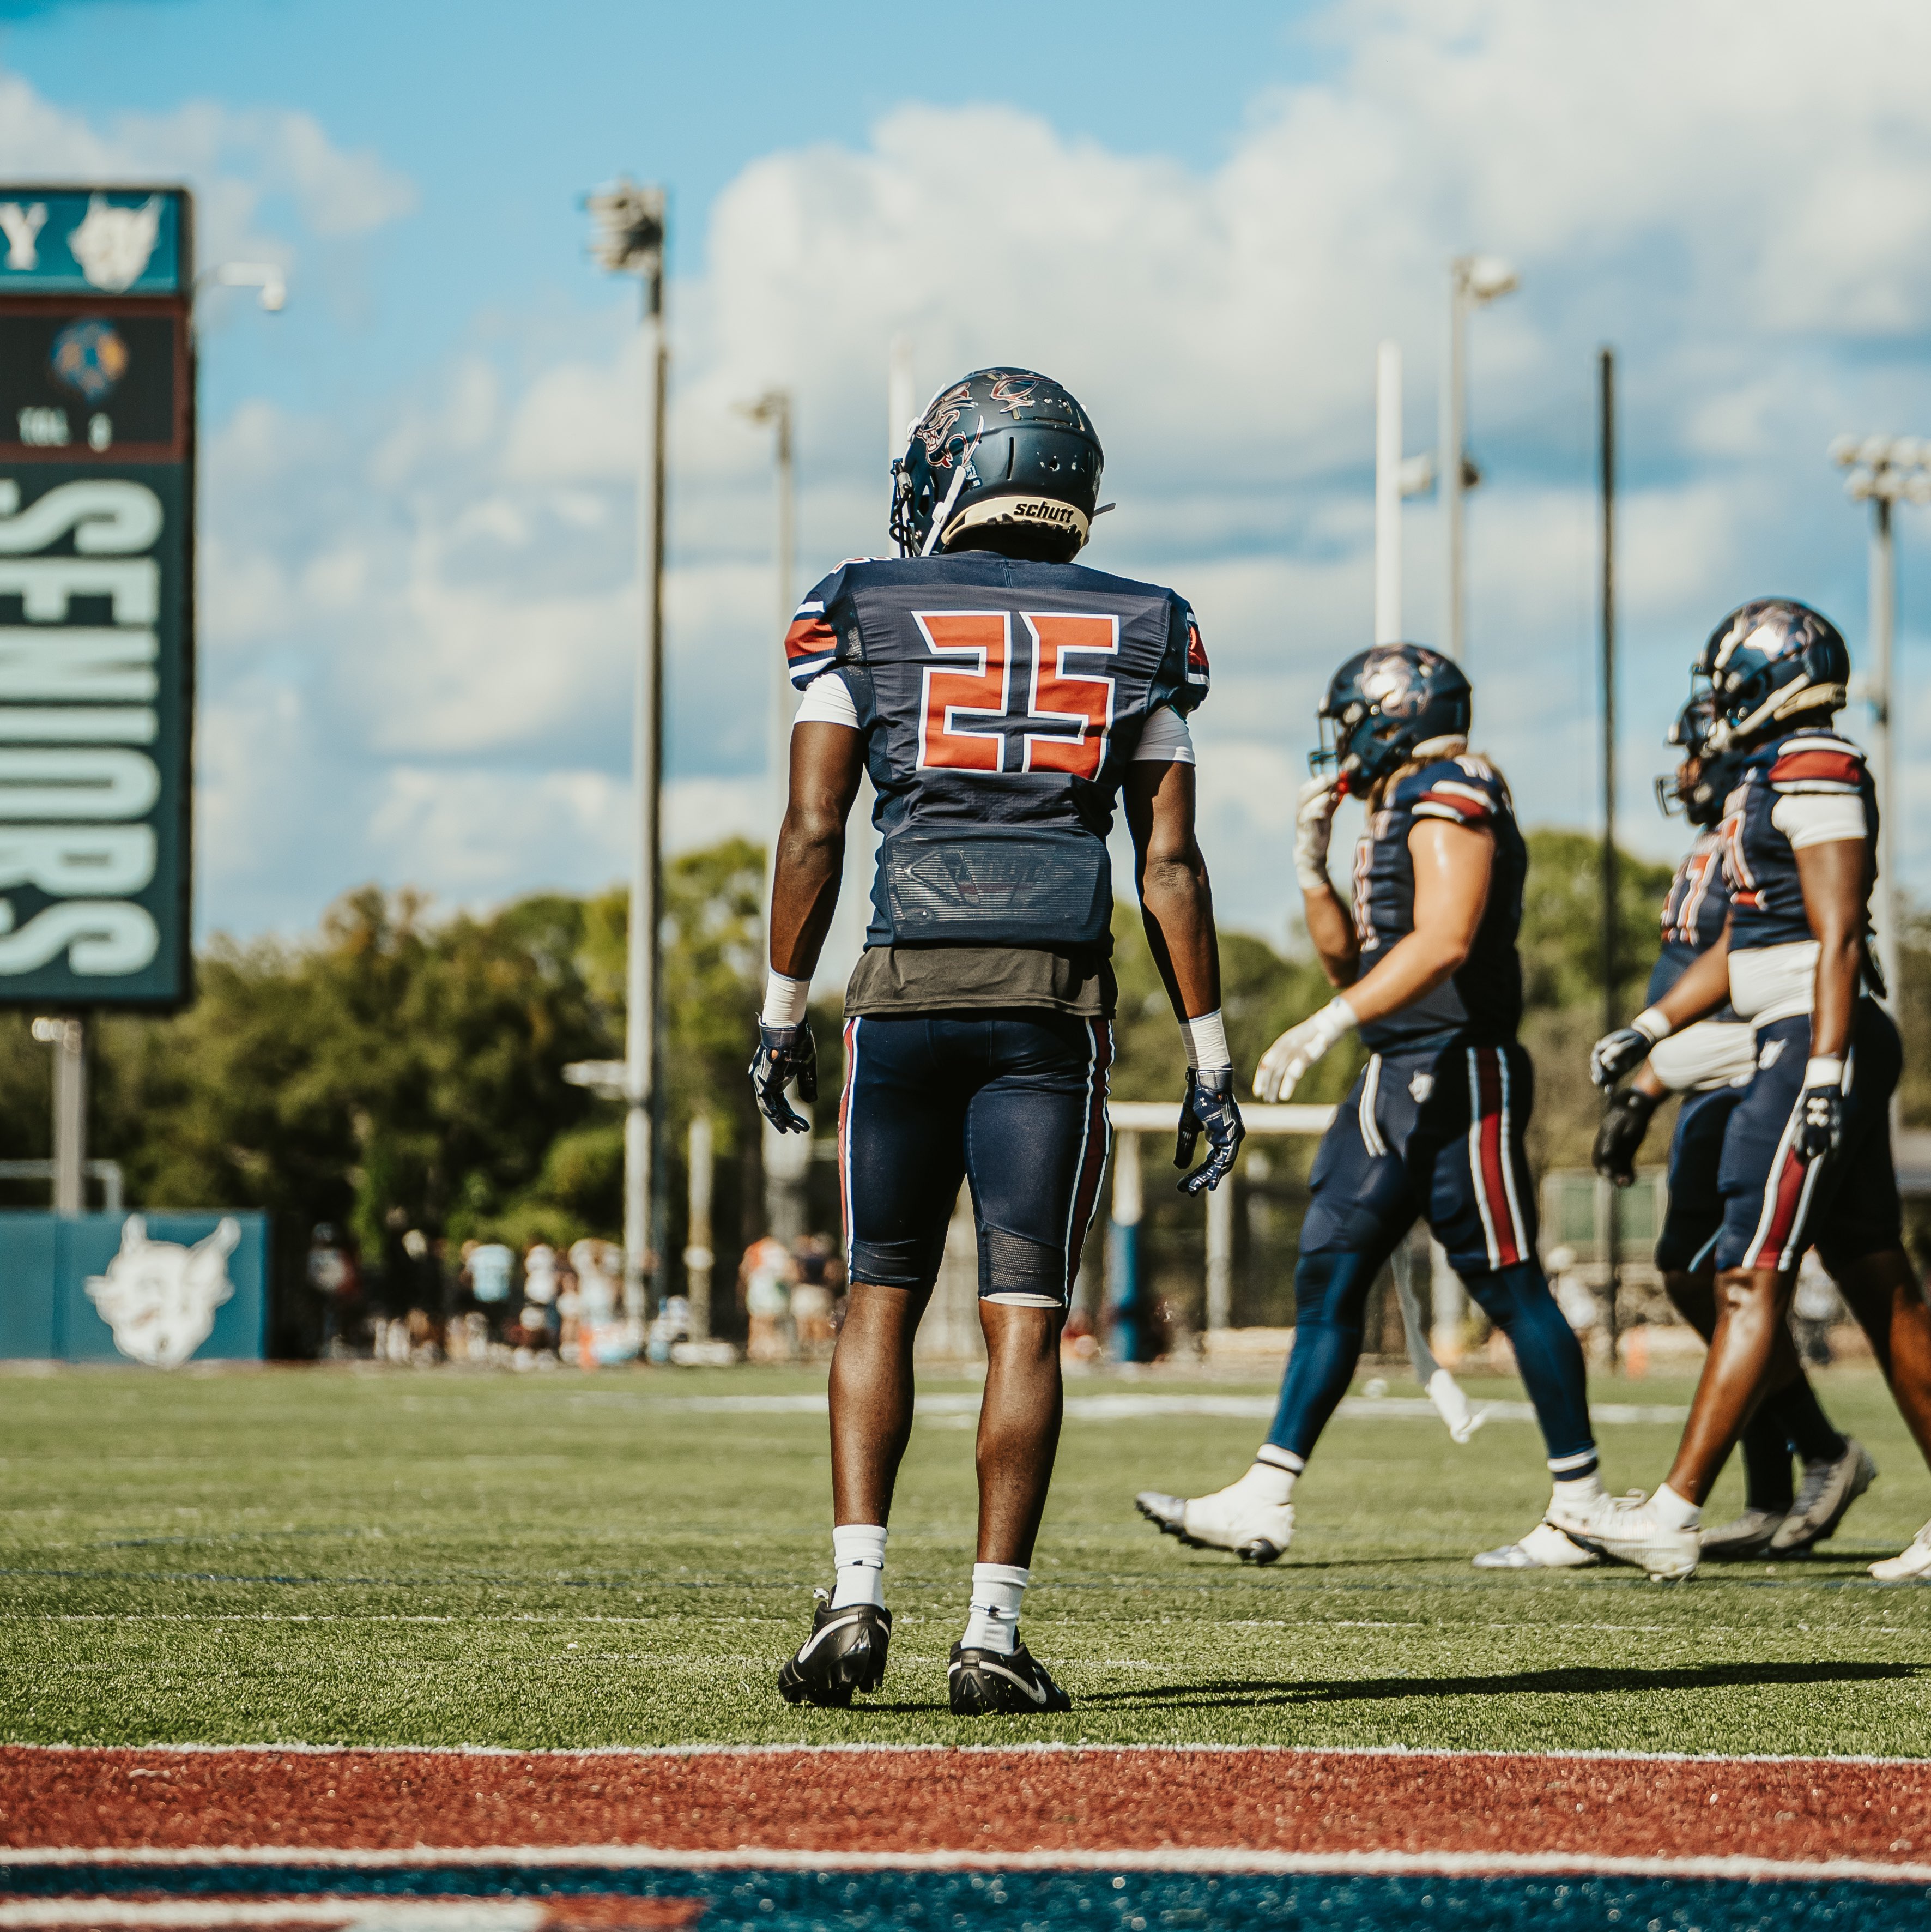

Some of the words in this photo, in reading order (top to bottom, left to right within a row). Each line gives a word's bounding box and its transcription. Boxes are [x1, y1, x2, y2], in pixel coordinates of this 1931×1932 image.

[0, 202, 49, 271] Y
[1013, 500, 1074, 523] schutt
[0, 478, 164, 977] SENIORS
[911, 610, 1119, 781] 25
